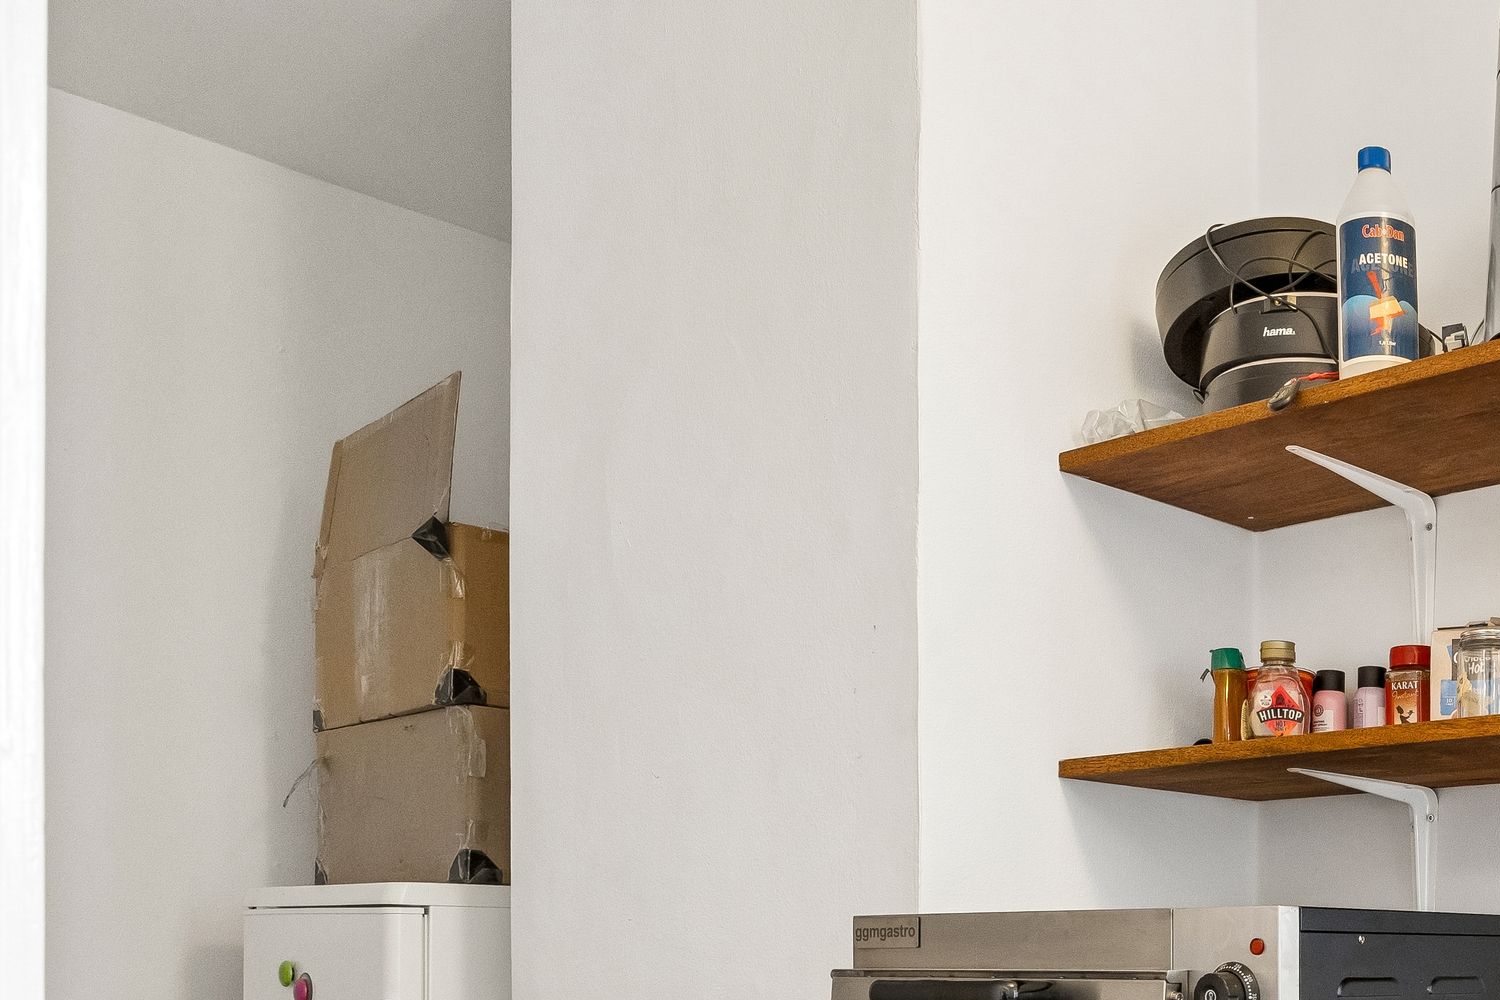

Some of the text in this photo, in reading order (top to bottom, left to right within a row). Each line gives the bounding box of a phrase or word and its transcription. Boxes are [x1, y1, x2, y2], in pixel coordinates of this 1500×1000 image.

[1359, 252, 1408, 268] ACETONE
[1391, 681, 1419, 690] KARAT
[1259, 709, 1302, 722] HILLTOP
[855, 925, 916, 941] ggmgastro
